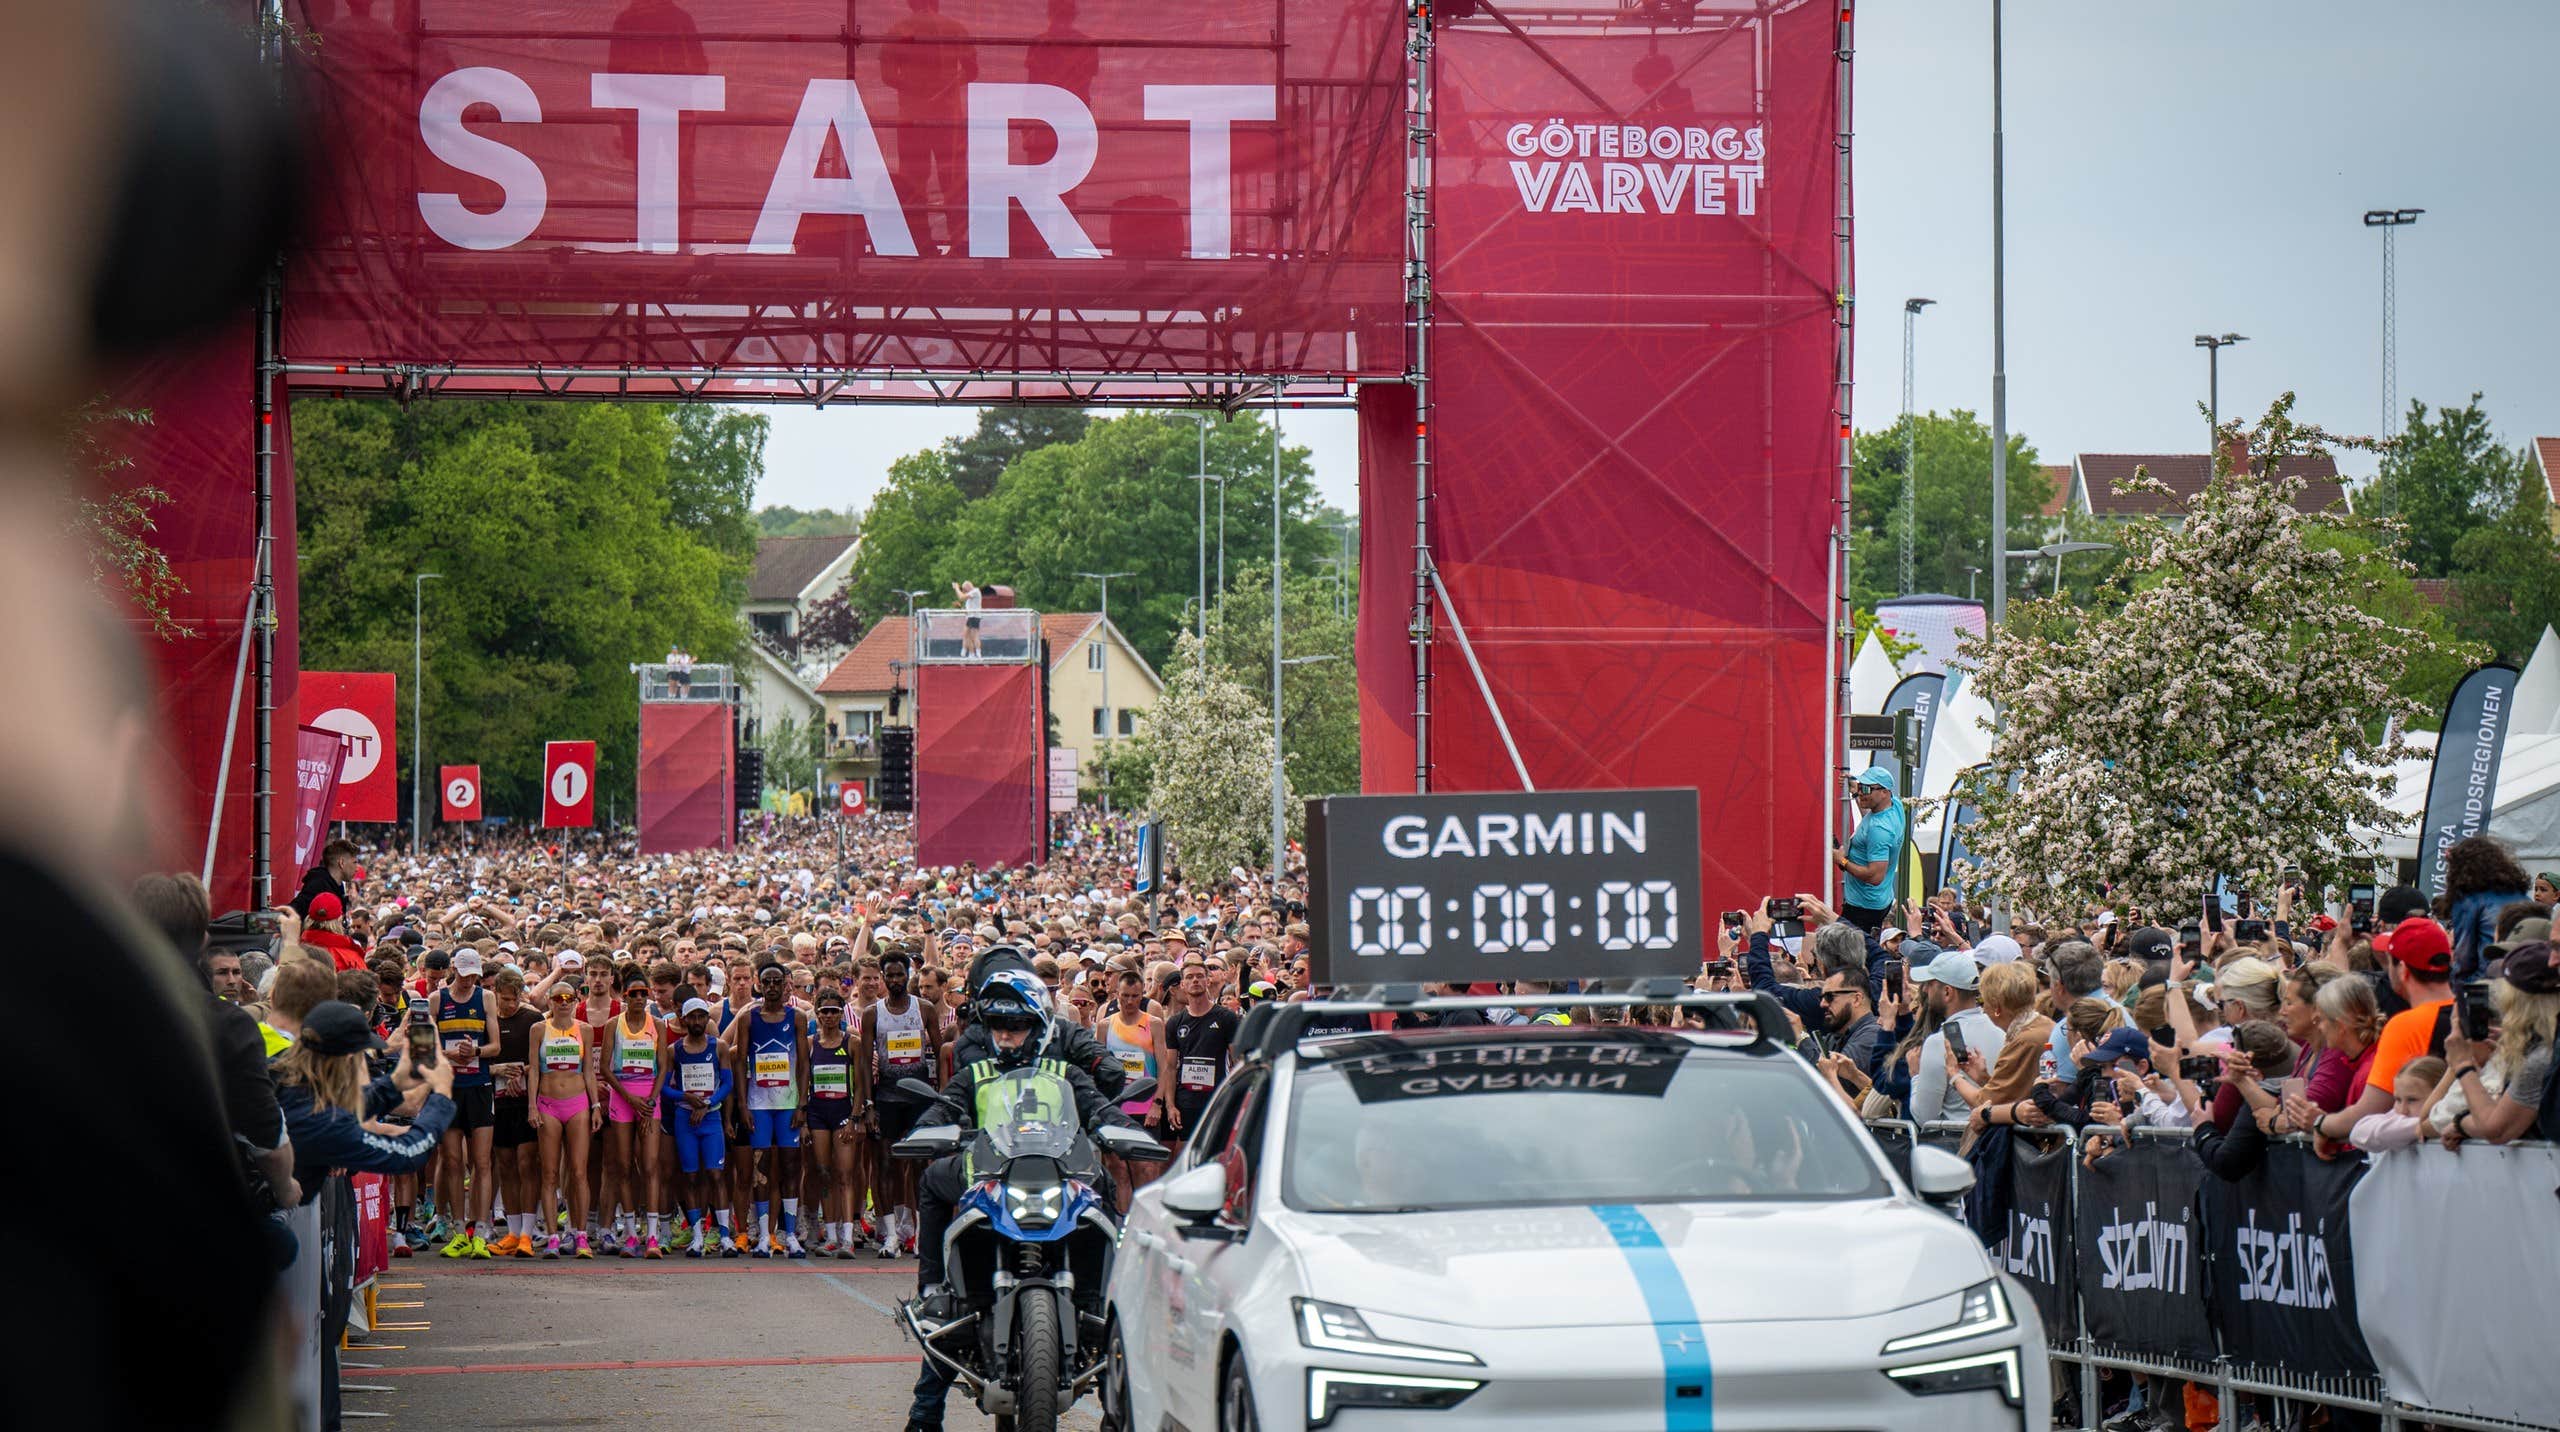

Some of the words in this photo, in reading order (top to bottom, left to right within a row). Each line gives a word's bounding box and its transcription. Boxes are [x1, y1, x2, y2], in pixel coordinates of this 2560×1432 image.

[1506, 118, 1766, 160] GÖTEBORGS
[417, 67, 1277, 260] START
[1509, 161, 1764, 216] VARVET
[455, 785, 467, 802] 2
[563, 772, 573, 798] 1
[850, 792, 856, 803] 3
[1382, 810, 1647, 858] GARMIN
[2431, 824, 2456, 896] VÄSTRA
[1349, 880, 1679, 956] 00:00:00
